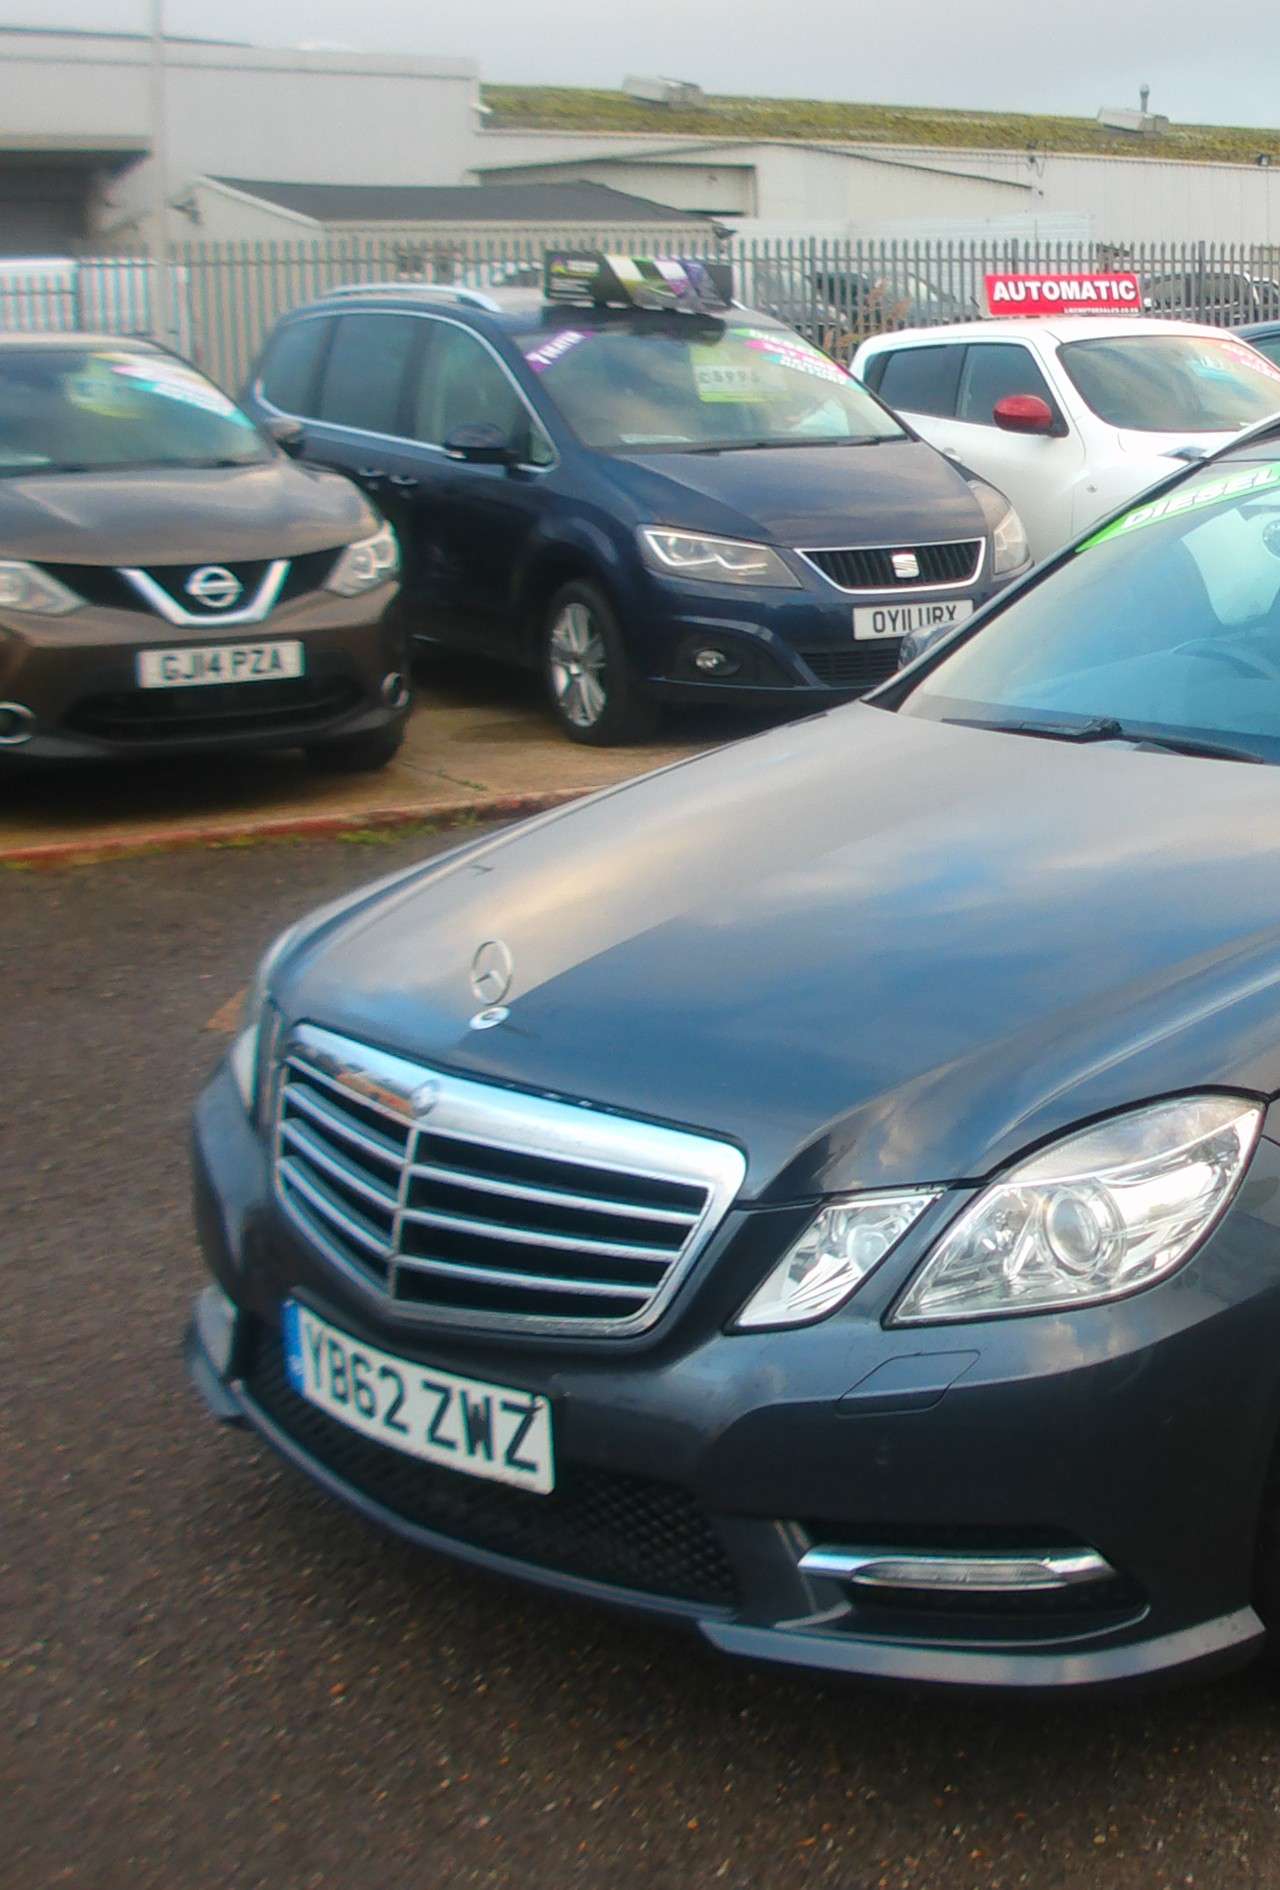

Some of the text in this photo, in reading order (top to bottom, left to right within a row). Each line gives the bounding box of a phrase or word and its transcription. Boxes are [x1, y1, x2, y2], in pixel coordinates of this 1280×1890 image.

[993, 280, 1137, 301] AUTOMATIC
[1121, 468, 1280, 529] DIESEL
[160, 649, 282, 681] GJ14 PZA
[305, 1322, 542, 1473] YB62 ZWZ
